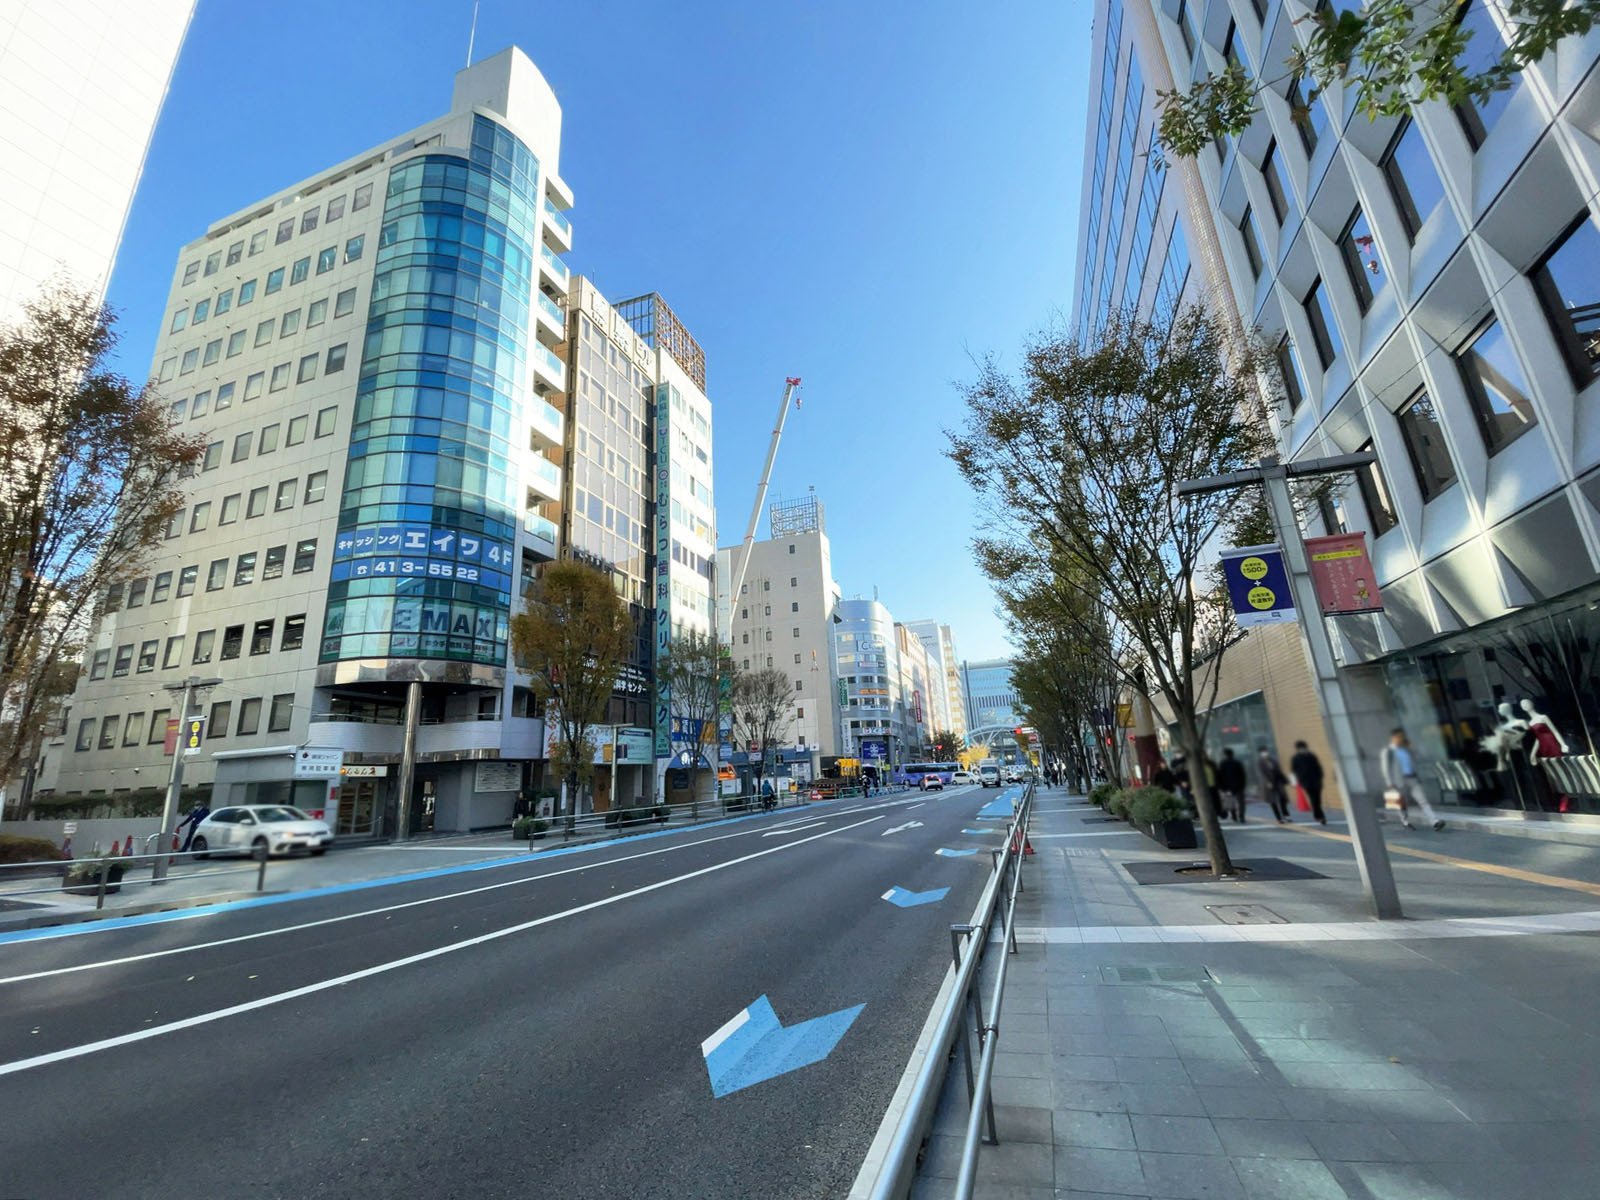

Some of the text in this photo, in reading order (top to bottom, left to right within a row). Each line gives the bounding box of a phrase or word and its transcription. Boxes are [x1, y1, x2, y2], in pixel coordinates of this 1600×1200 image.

[338, 531, 513, 566] キャッシング エイワ 4F
[374, 561, 479, 581] 413-5522
